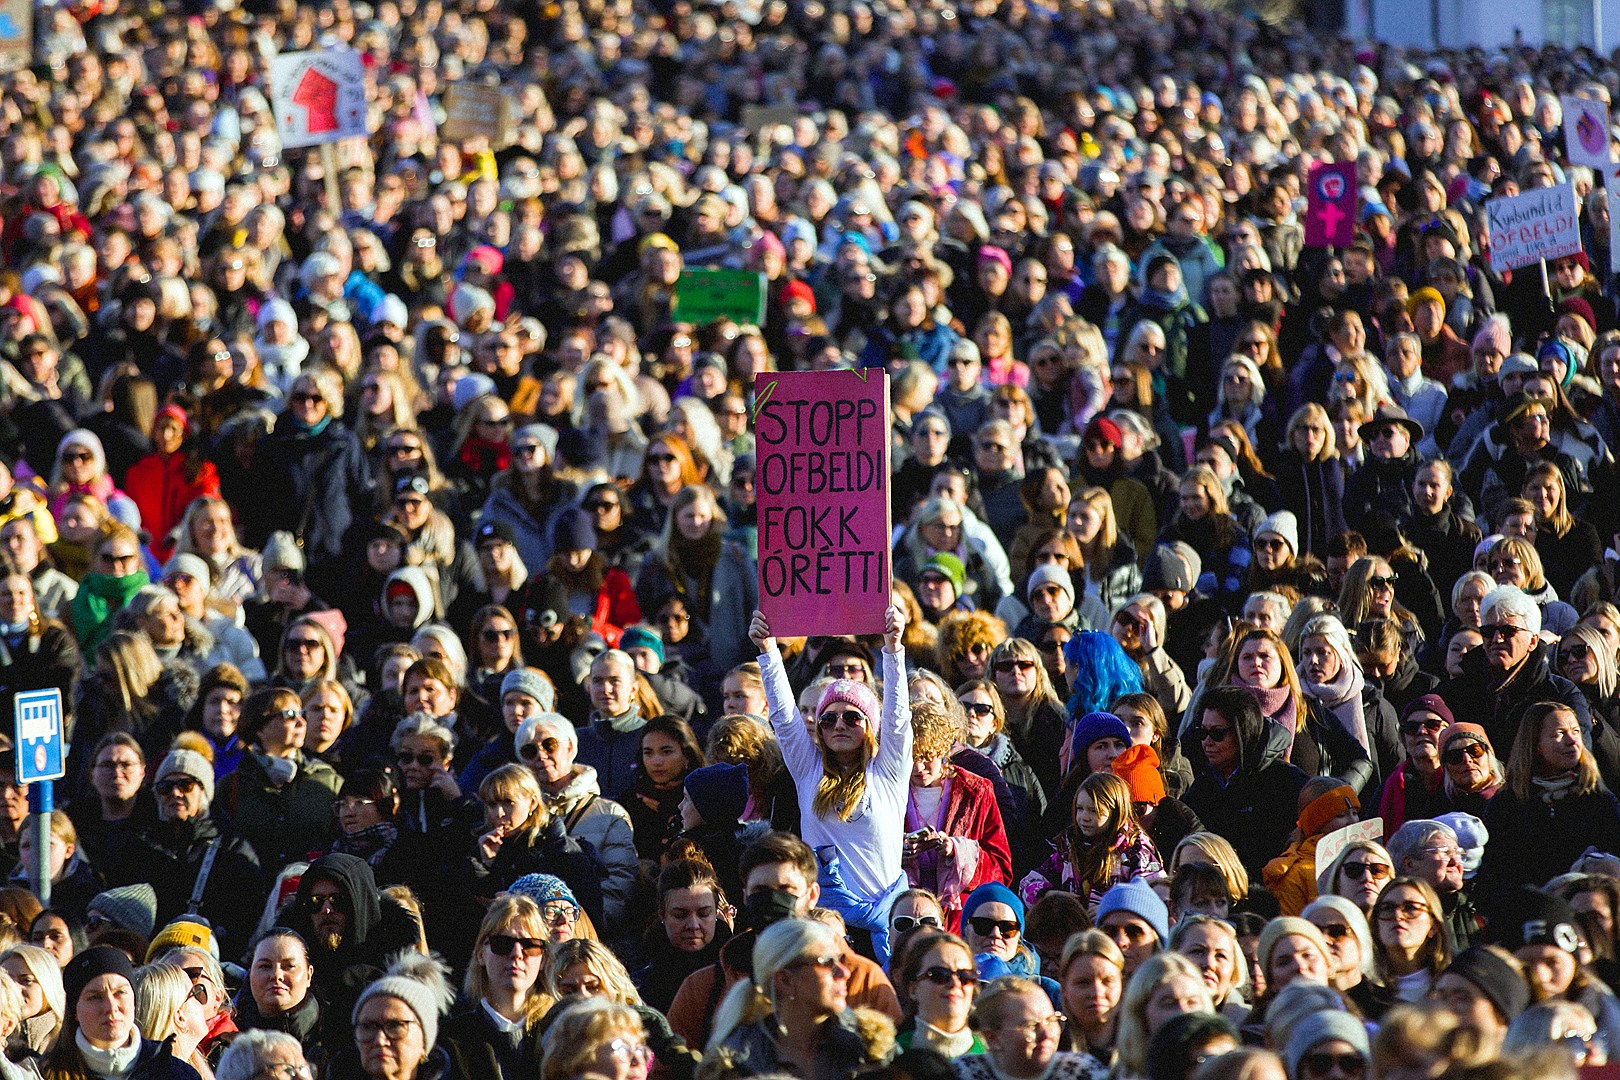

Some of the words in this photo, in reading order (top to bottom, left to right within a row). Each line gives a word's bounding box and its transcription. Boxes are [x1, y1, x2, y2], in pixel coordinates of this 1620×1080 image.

[1492, 215, 1573, 252] OFBELDI
[761, 399, 877, 446] STOPP
[762, 449, 881, 495] OFBELDI
[764, 505, 861, 550] FOKK
[762, 545, 883, 597] ÓRÉTTI
